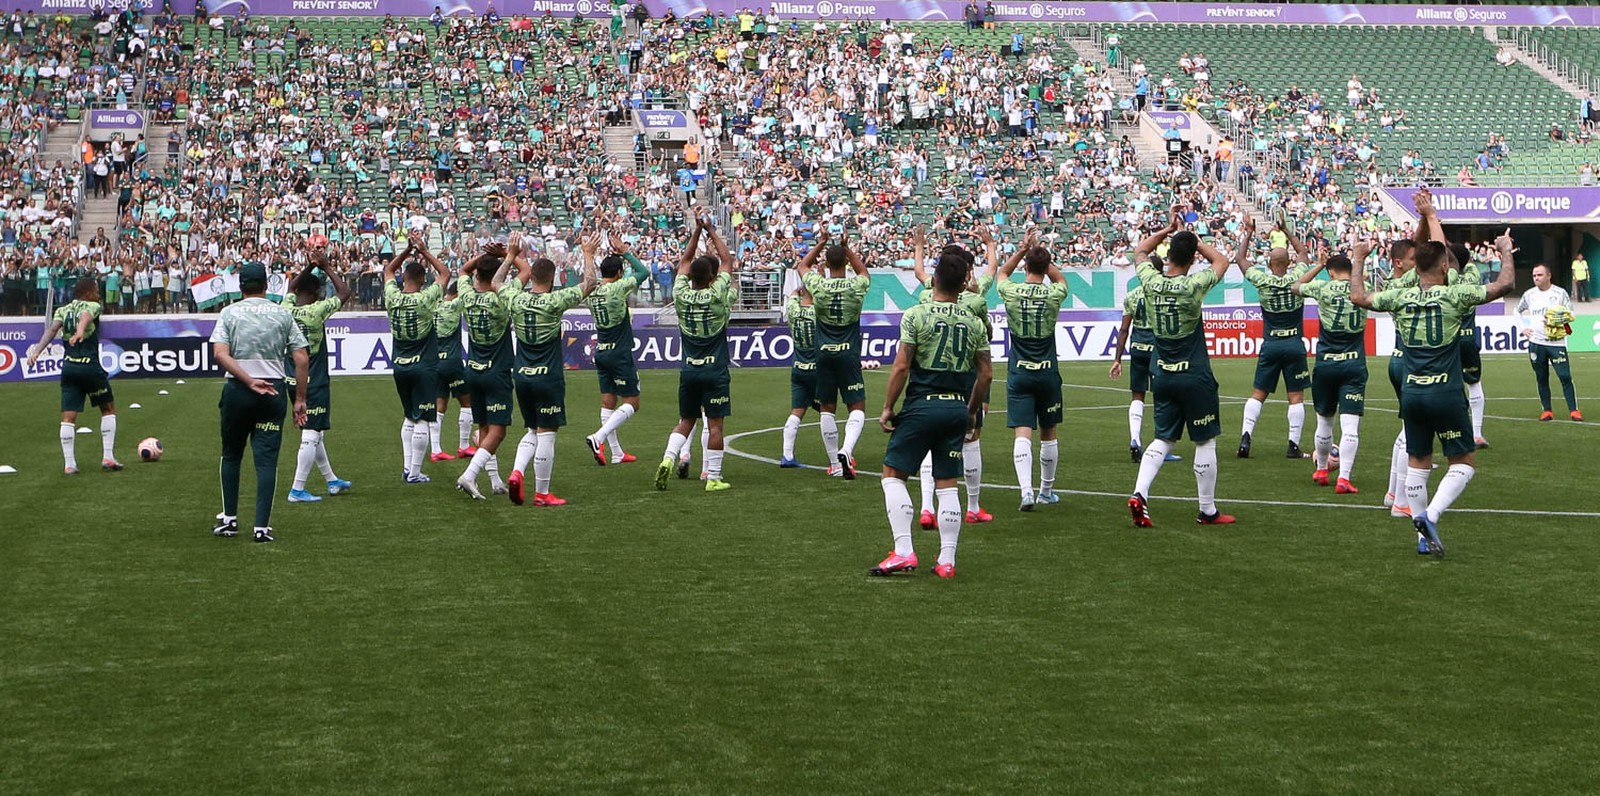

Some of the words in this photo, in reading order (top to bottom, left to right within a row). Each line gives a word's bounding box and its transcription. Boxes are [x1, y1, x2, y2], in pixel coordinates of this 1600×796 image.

[533, 2, 575, 12] Allianz
[835, 2, 876, 17] Parque
[1045, 5, 1086, 18] Seguros
[1207, 7, 1245, 17] PREVENT
[1245, 7, 1275, 17] SENIOR
[1416, 8, 1452, 19] Allianz
[1470, 9, 1506, 21] Seguros
[97, 114, 125, 123] Allianz
[1431, 194, 1487, 210] Allianz
[1516, 194, 1570, 214] Parque
[1016, 284, 1050, 298] crefisa
[930, 304, 968, 318] crefisa
[1020, 299, 1047, 337] 17
[1405, 302, 1444, 347] 20
[932, 320, 968, 370] 29
[255, 421, 280, 433] crefisa
